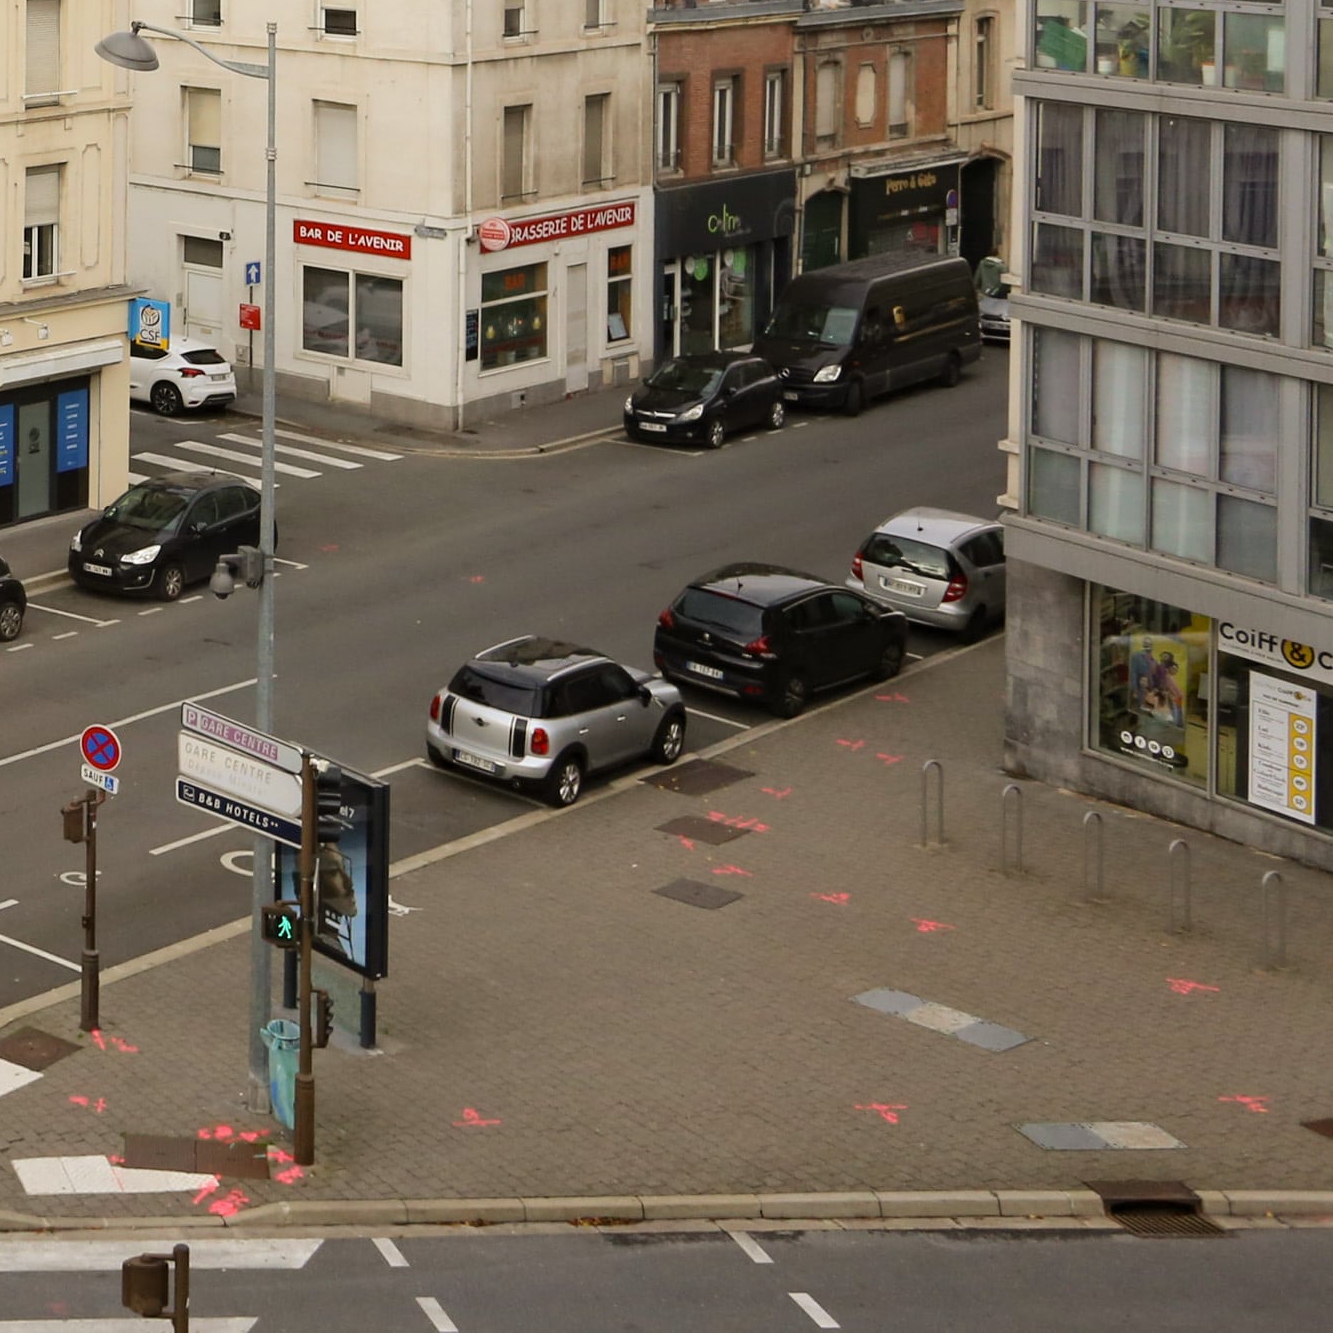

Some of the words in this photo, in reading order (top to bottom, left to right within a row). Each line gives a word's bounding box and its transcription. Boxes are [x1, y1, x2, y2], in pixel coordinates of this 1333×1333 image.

[510, 217, 567, 244] BRASSERIE
[571, 214, 585, 232] DE
[587, 207, 632, 229] L'AVENIR
[300, 226, 322, 240] BAR
[327, 231, 343, 244] DE
[348, 234, 404, 252] L'AVENIR
[140, 329, 161, 341] CSF
[188, 711, 196, 724] P
[202, 718, 230, 739] GARE
[234, 730, 278, 758] CENTRE
[84, 768, 103, 784] SAUF
[185, 742, 216, 763] GARE
[225, 756, 272, 784] CENTRE
[198, 792, 221, 809] B&B
